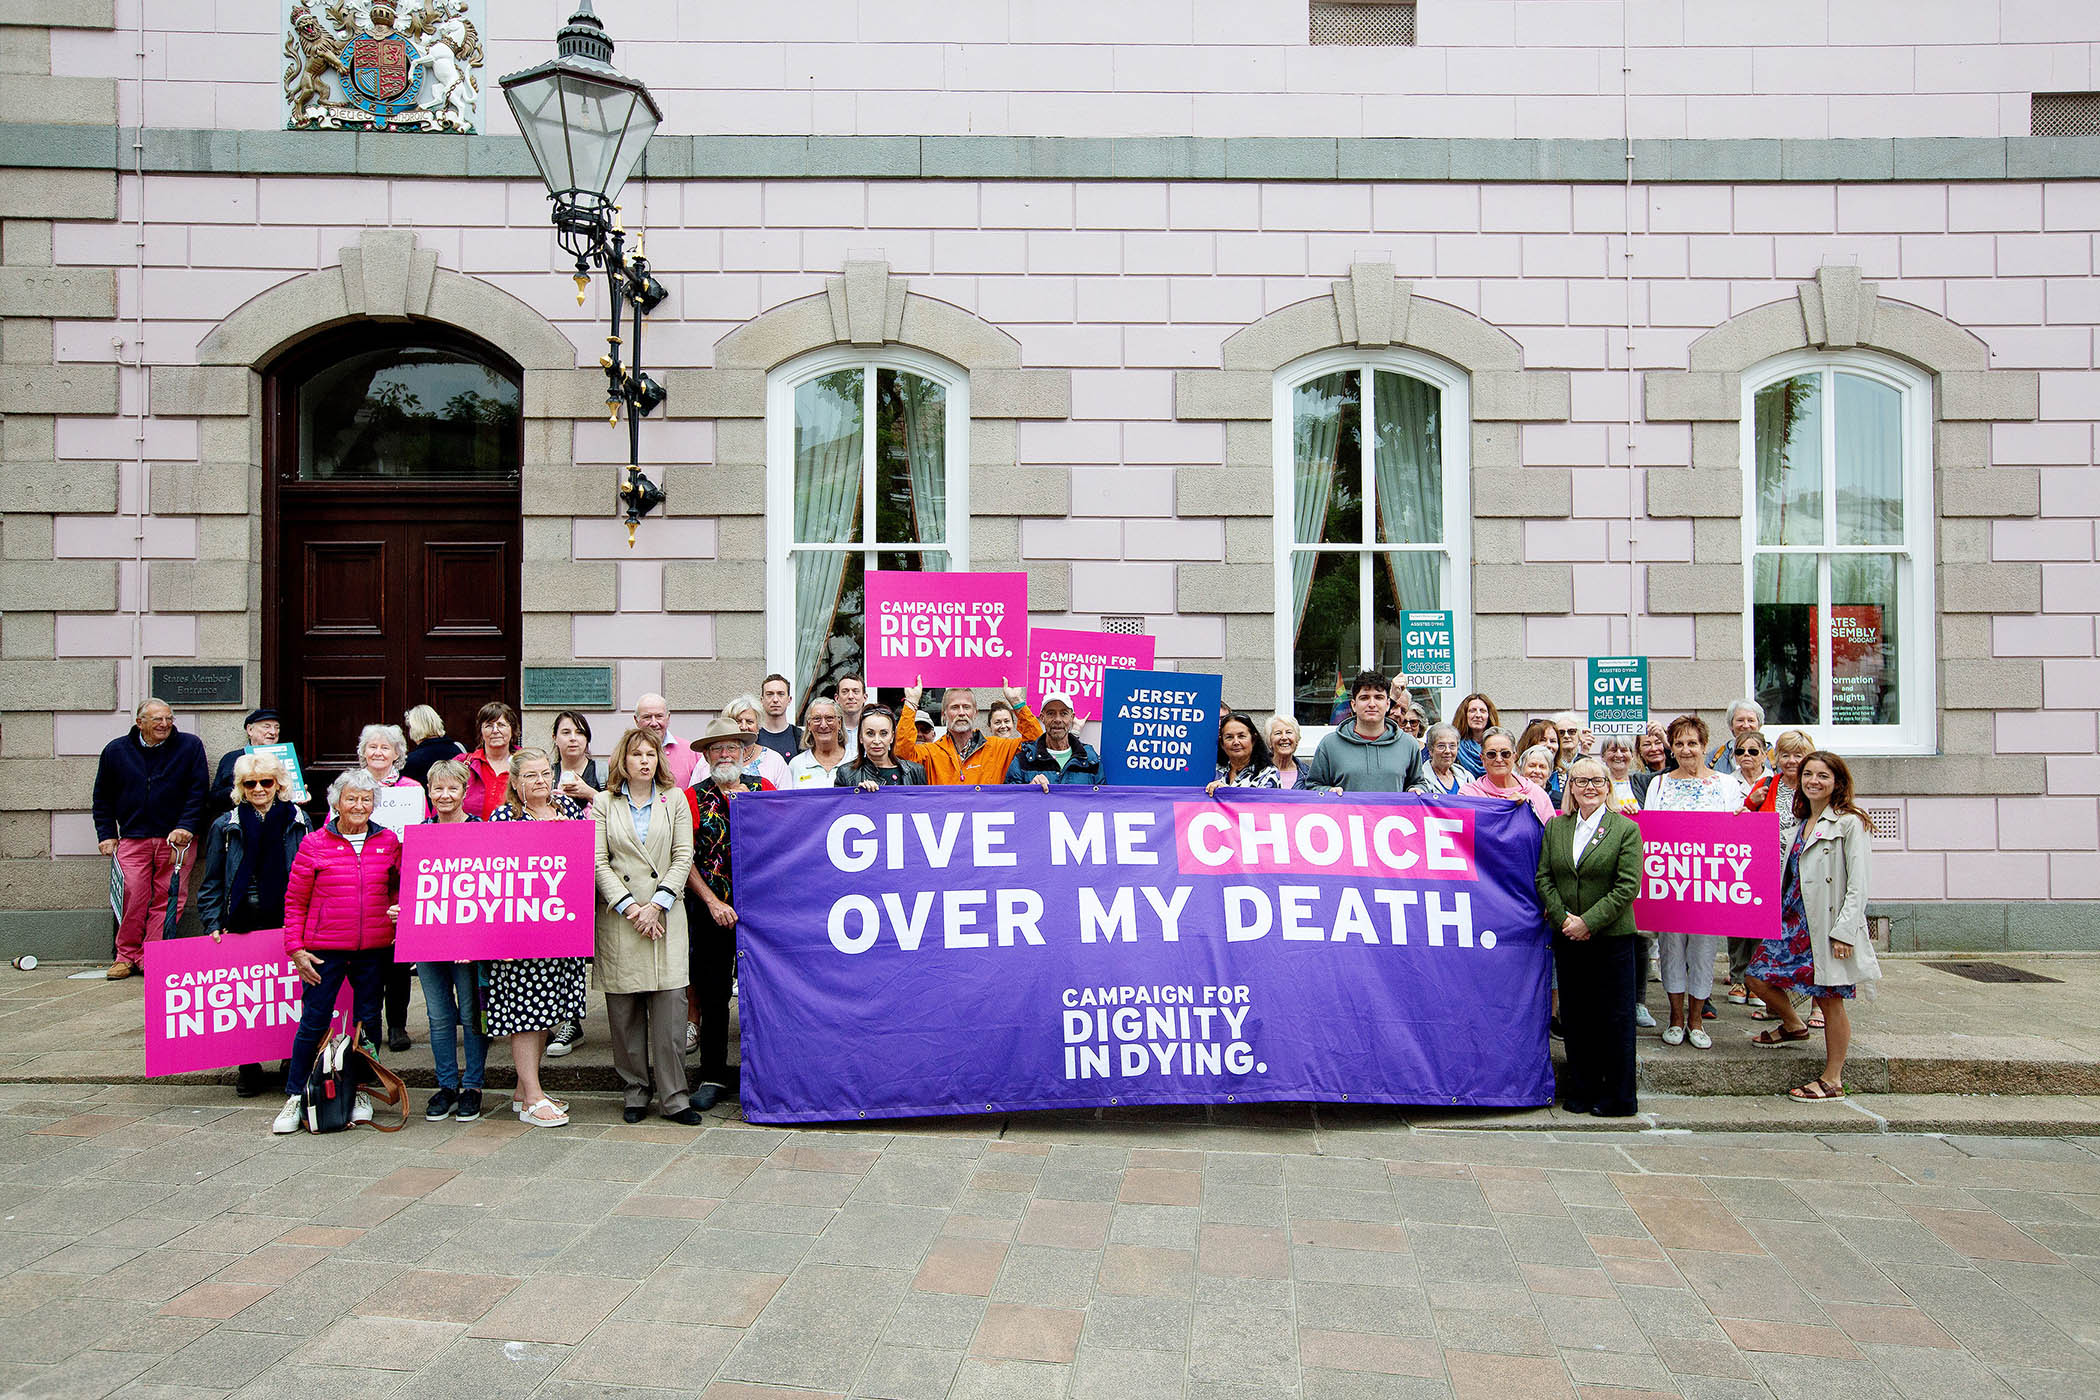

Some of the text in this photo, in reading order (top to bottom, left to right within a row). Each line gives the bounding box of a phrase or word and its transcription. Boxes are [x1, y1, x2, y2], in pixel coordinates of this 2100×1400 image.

[880, 601, 1005, 614] CAMPAIGN FOR
[880, 614, 1005, 636] DIGNITY
[1406, 631, 1450, 646] GIVE
[880, 636, 1013, 658] IN DYING.
[1407, 649, 1450, 658] ME THE
[1040, 651, 1137, 667] CAMPAIGN FOR
[1407, 662, 1451, 672] CHOICE
[163, 674, 189, 683] States
[1038, 678, 1062, 695] IN
[1407, 676, 1451, 685] ROUTE 2
[1594, 677, 1643, 692] GIVE
[177, 686, 217, 695] Entrance
[1127, 689, 1198, 705] JERSEY
[1832, 693, 1866, 703] nsights
[1594, 695, 1643, 706] ME THE
[1117, 705, 1205, 722] ASSISTED
[1594, 709, 1643, 720] CHOICE
[1133, 722, 1188, 738] DYING
[1593, 724, 1643, 733] ROUTE 2
[1126, 739, 1192, 755] ACTION
[1126, 756, 1189, 771] GROUP.
[826, 811, 1468, 872] GIVE ME CHOICE
[1713, 844, 1752, 857] FOR
[418, 856, 567, 873] CAMPAIGN FOR
[1644, 855, 1752, 881] GNITY
[416, 871, 567, 899] DIGNITY
[1649, 878, 1763, 905] DYING.
[414, 896, 576, 925] IN DYING.
[827, 885, 1497, 955] OVER MY DEATH.
[165, 963, 279, 988] CAMPAIGN
[165, 975, 300, 1014] DIGNIT
[1062, 985, 1251, 1007] CAMPAIGN FOR
[166, 1011, 205, 1040] IN
[1062, 1006, 1251, 1044] DIGNITY
[1064, 1041, 1268, 1080] IN DYING.
